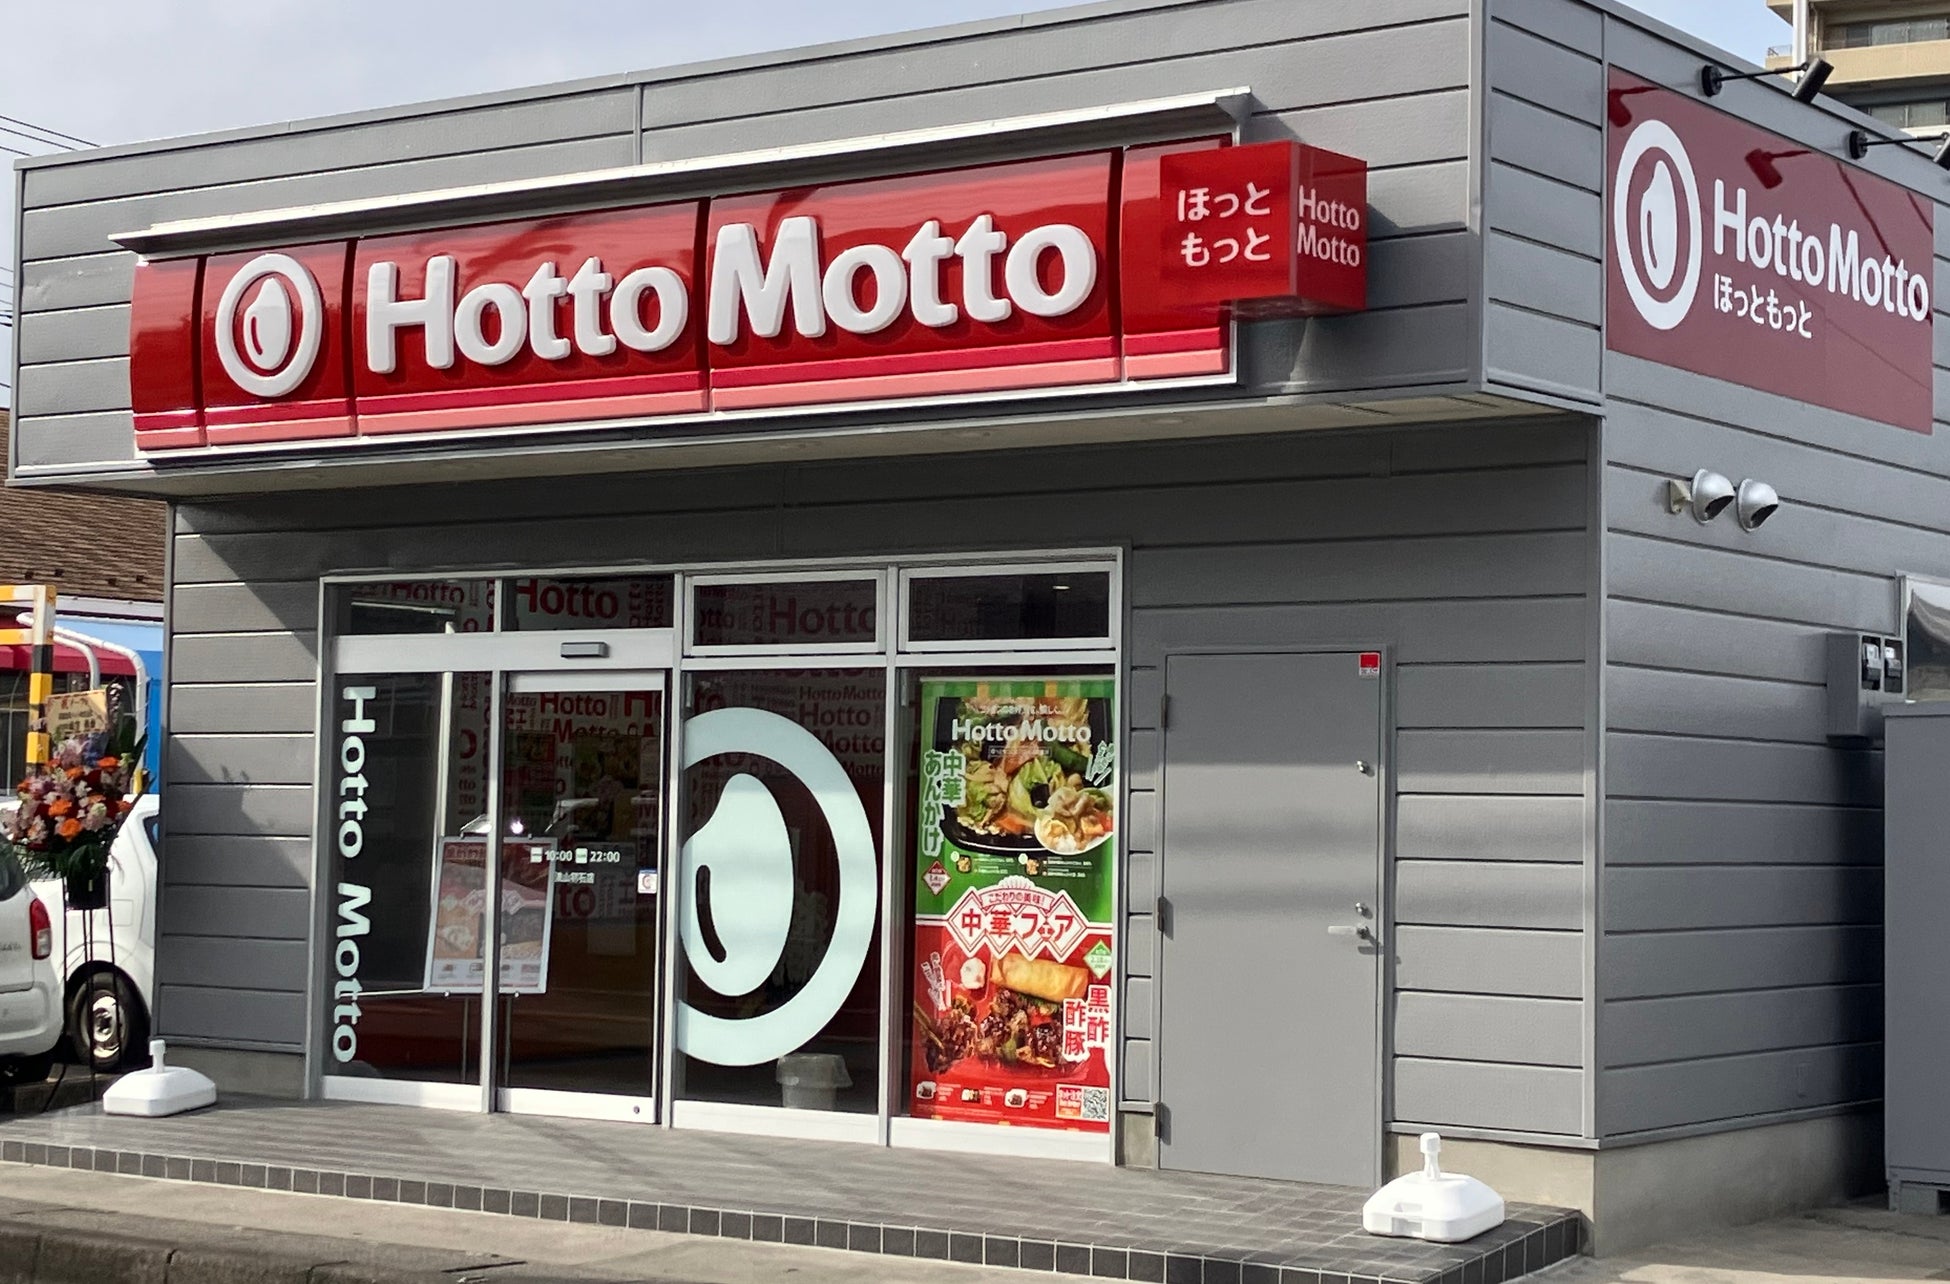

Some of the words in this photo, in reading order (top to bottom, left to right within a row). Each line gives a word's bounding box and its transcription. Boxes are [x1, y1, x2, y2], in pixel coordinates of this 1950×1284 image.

[1177, 182, 1271, 222] ほっと
[1297, 185, 1361, 231] Hotto
[1179, 227, 1272, 267] もっと
[1296, 221, 1361, 268] Motto
[366, 255, 689, 374] Hotto
[708, 214, 1096, 346] Motto
[1713, 272, 1813, 339] ほっともっと
[799, 702, 872, 727] Hotto
[338, 686, 377, 859] Hotto
[942, 749, 964, 802] 中華
[923, 751, 943, 855] あんかけ
[545, 850, 573, 862] 10:00
[589, 850, 621, 863] 22:00
[961, 908, 1075, 943] 中華フェア
[333, 882, 372, 1063] Motto
[1064, 999, 1087, 1056] 酢豚
[1087, 986, 1110, 1044] 黒酢
